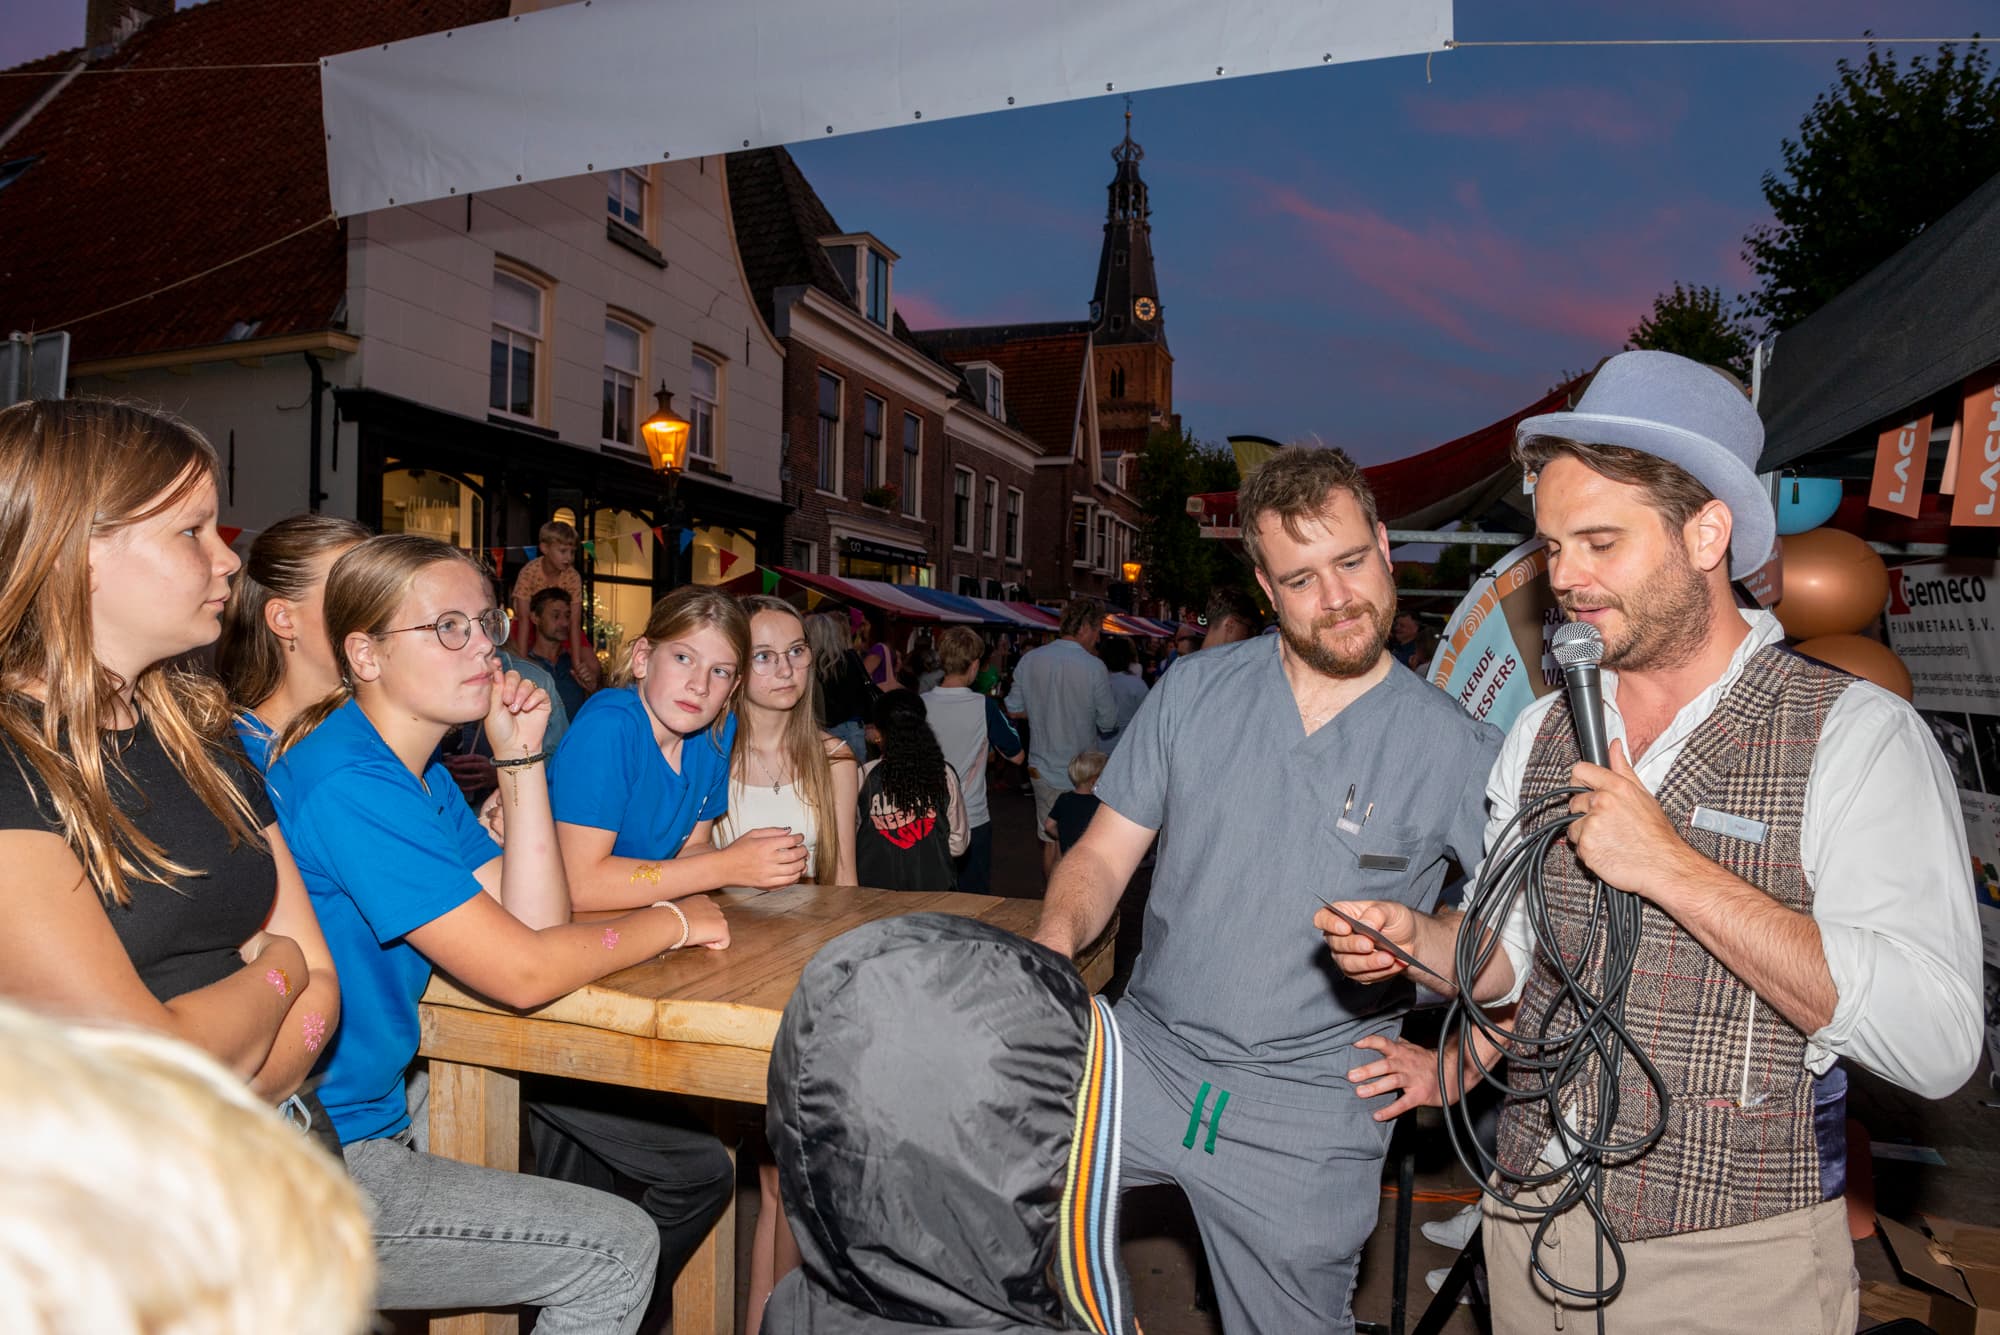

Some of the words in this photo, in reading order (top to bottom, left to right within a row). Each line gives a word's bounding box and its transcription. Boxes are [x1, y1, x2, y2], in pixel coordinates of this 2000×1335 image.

[1903, 575, 1986, 607] Gemeco
[1891, 619, 1964, 634] FIJNMETAAL
[1968, 617, 1995, 632] B.V.
[879, 817, 937, 850] LOVE
